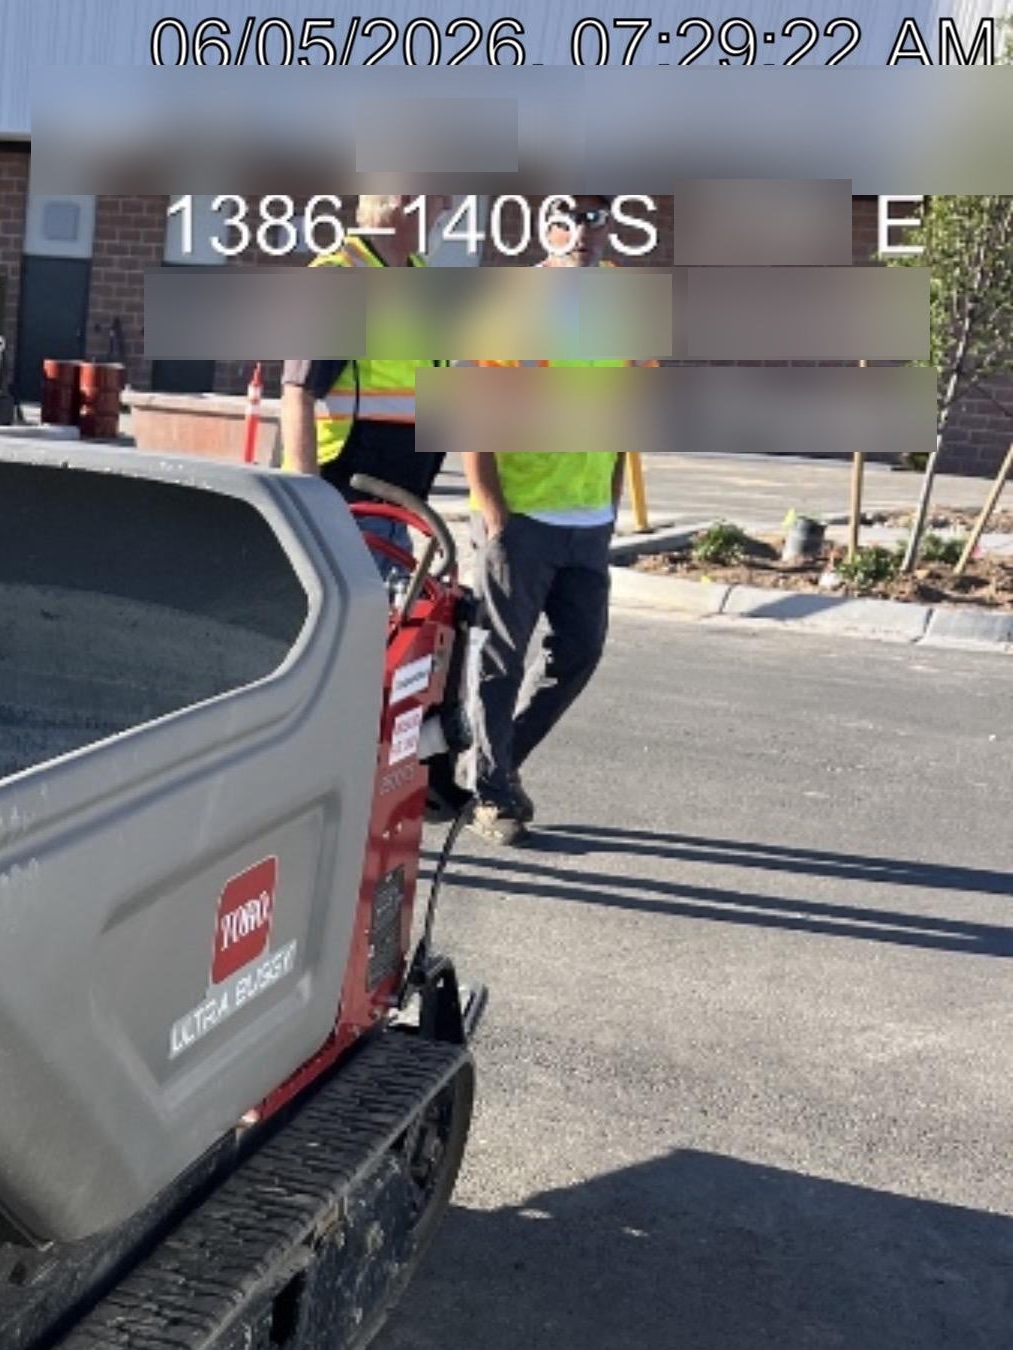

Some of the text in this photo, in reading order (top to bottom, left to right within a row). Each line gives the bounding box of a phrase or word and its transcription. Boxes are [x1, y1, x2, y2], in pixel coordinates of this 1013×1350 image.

[220, 890, 270, 951] TORO
[170, 939, 297, 1054] ULTRA BUGGY
